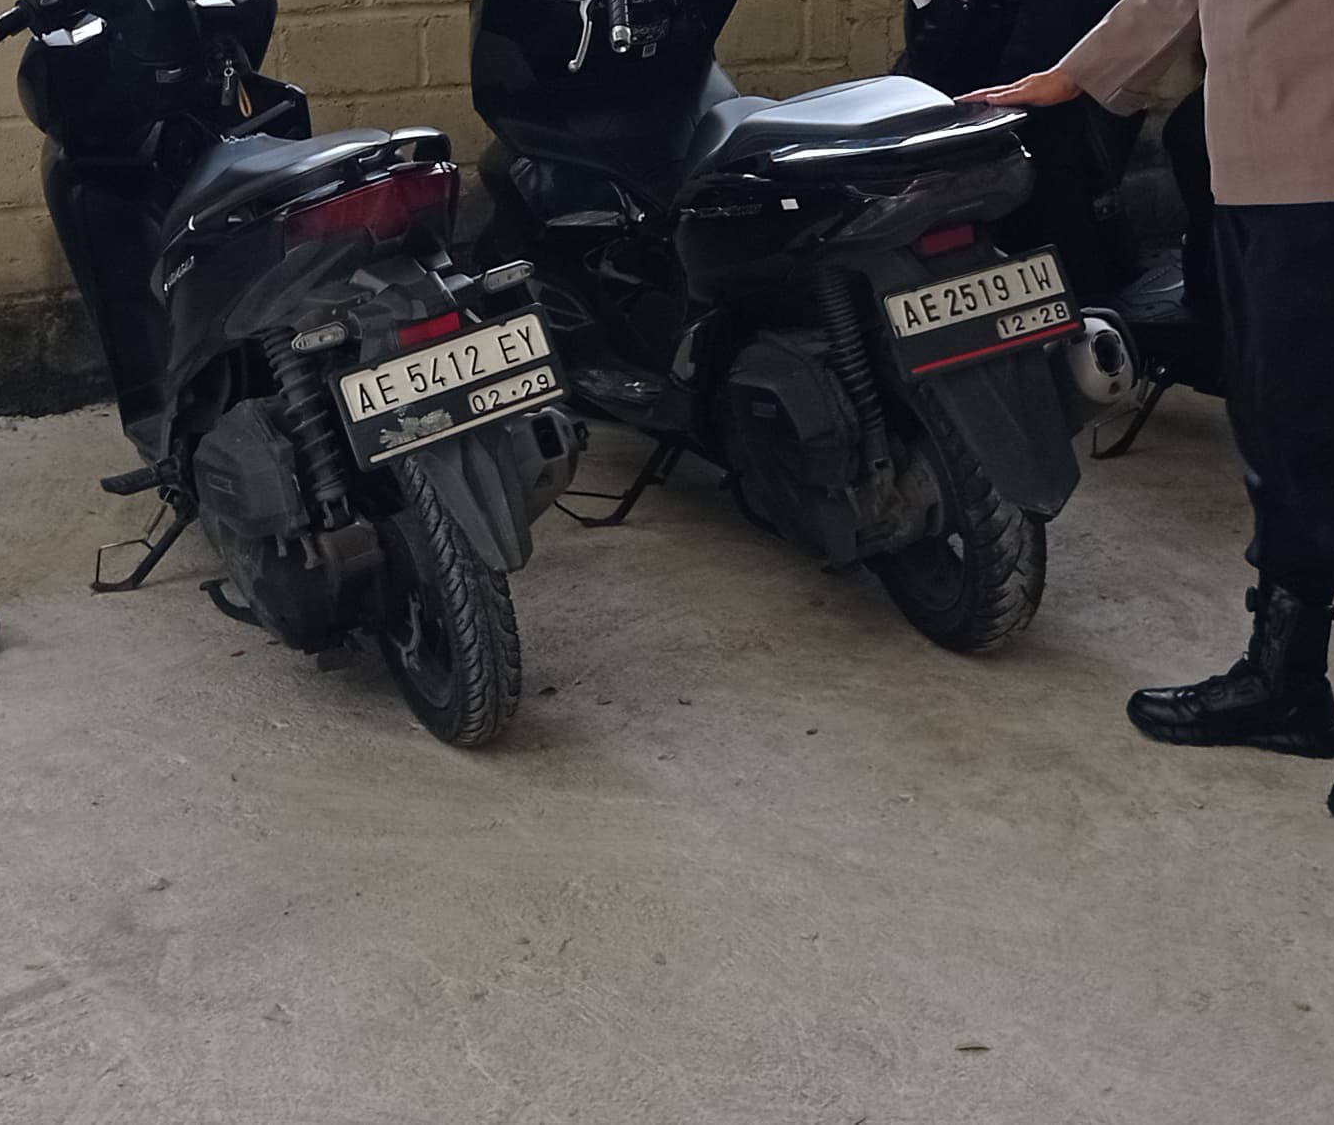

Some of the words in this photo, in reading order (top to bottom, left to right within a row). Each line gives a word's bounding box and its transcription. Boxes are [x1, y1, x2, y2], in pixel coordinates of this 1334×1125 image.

[903, 292, 941, 329] AE
[943, 274, 1010, 318] 2519
[1017, 261, 1052, 295] IW
[358, 372, 400, 414] AE
[406, 345, 487, 394] 5412
[497, 325, 537, 365] EY
